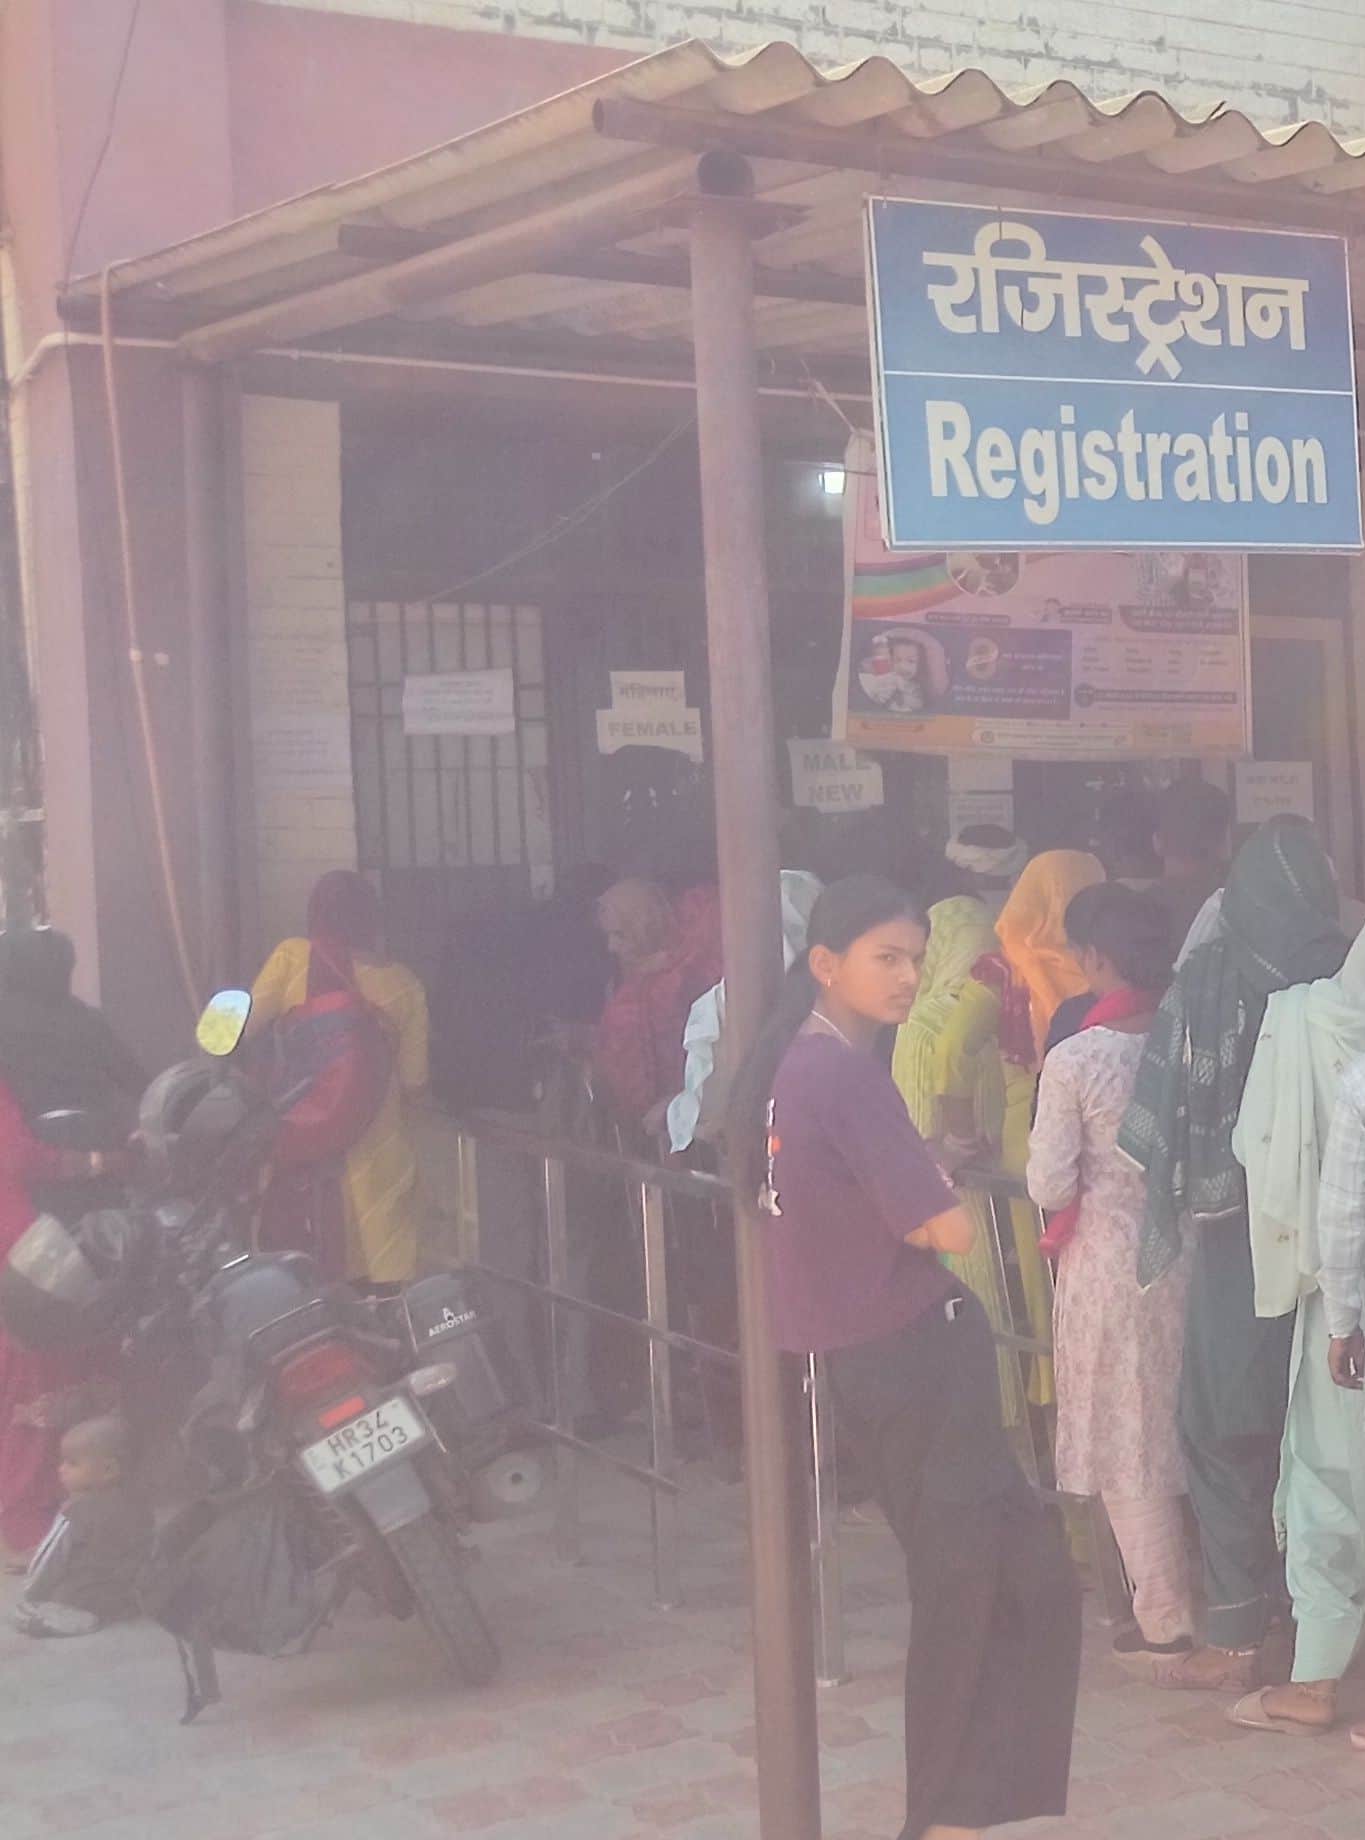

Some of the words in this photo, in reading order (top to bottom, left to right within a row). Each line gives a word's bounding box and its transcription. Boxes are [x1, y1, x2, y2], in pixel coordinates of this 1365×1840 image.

[922, 222, 1309, 380] रजिस्ट्रेशन
[925, 401, 1327, 525] Registration
[608, 720, 697, 737] FEMALE
[333, 1425, 408, 1480] K1703
